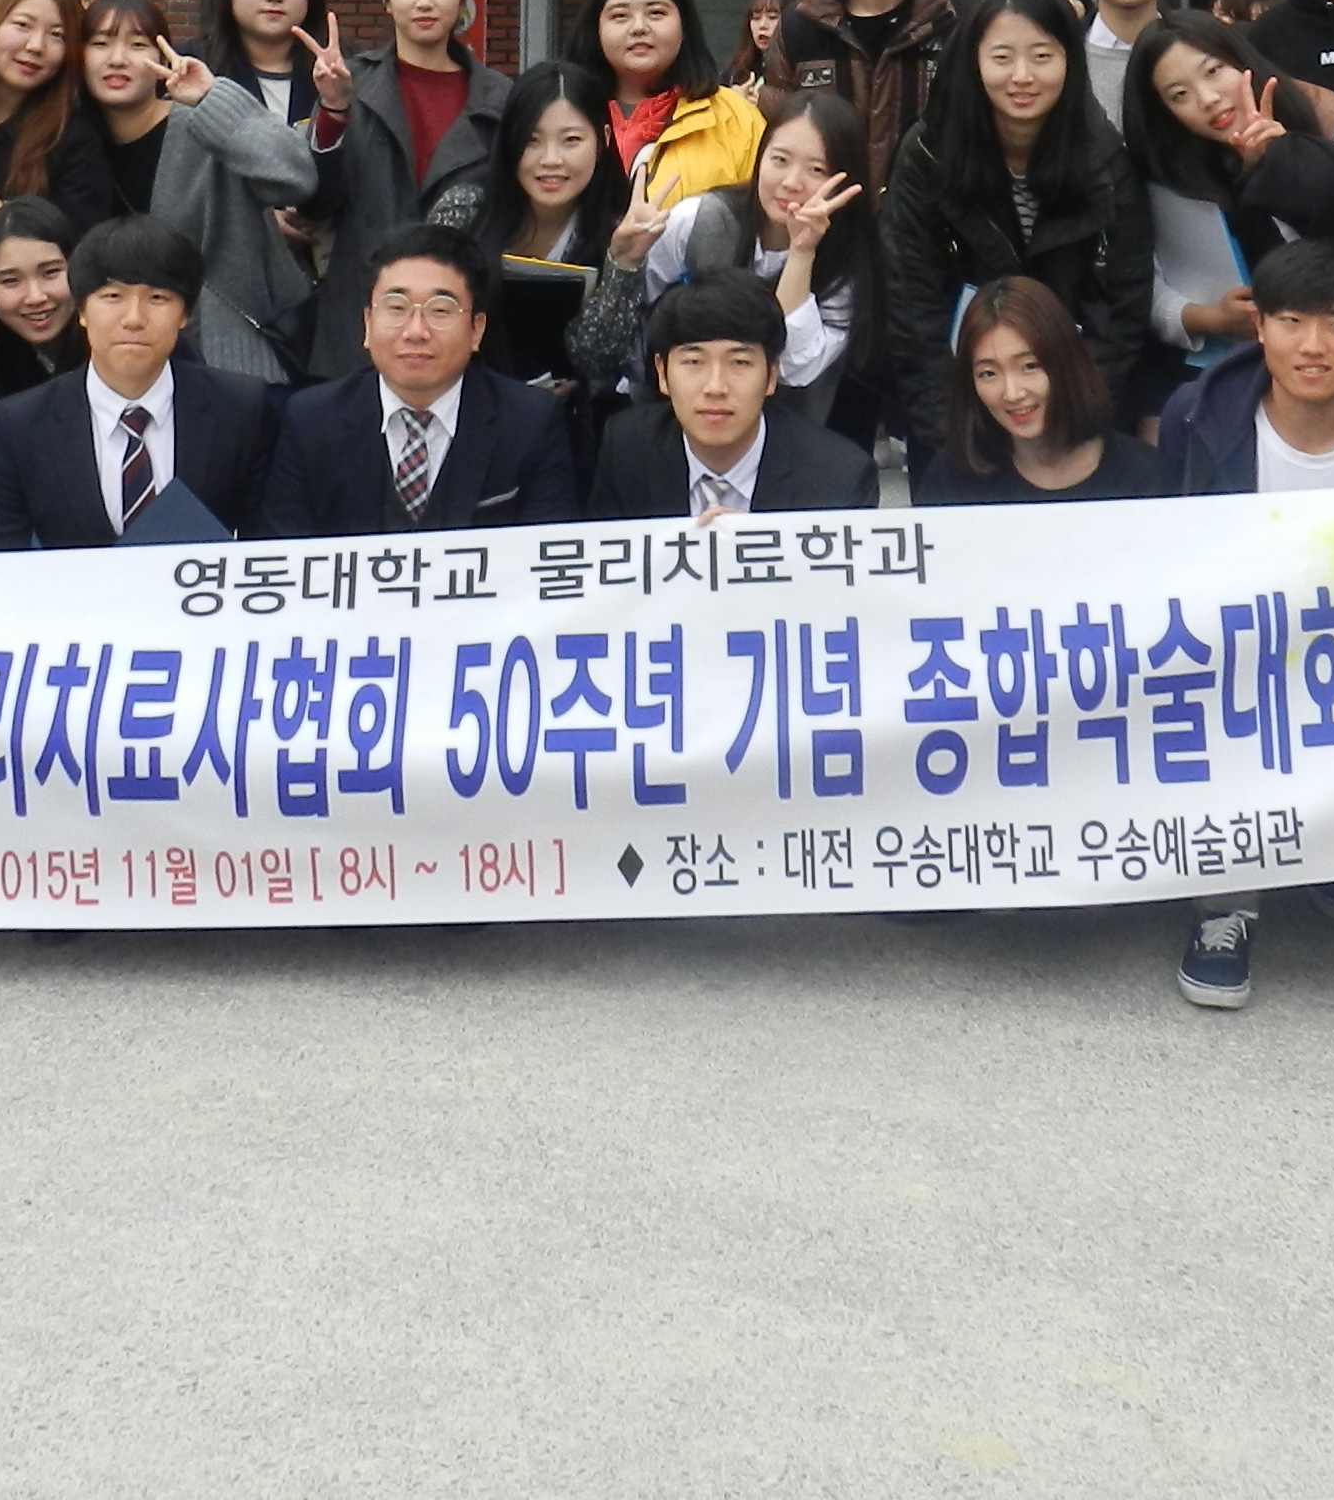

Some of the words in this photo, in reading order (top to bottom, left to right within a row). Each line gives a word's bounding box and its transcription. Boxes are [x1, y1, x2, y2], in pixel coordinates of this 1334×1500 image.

[173, 543, 499, 617] 영동대학교
[529, 522, 935, 600] 물리치료학과
[445, 623, 688, 810] 50주년
[725, 615, 865, 801] 기념
[121, 848, 198, 906] 11월
[214, 846, 294, 905] 01일
[339, 843, 398, 902] 8시
[458, 839, 536, 899] 18시
[666, 833, 740, 897] 장소
[783, 826, 855, 890] 대전
[872, 820, 1061, 890] 우송대학교
[1077, 806, 1305, 883] 우송예술회관
